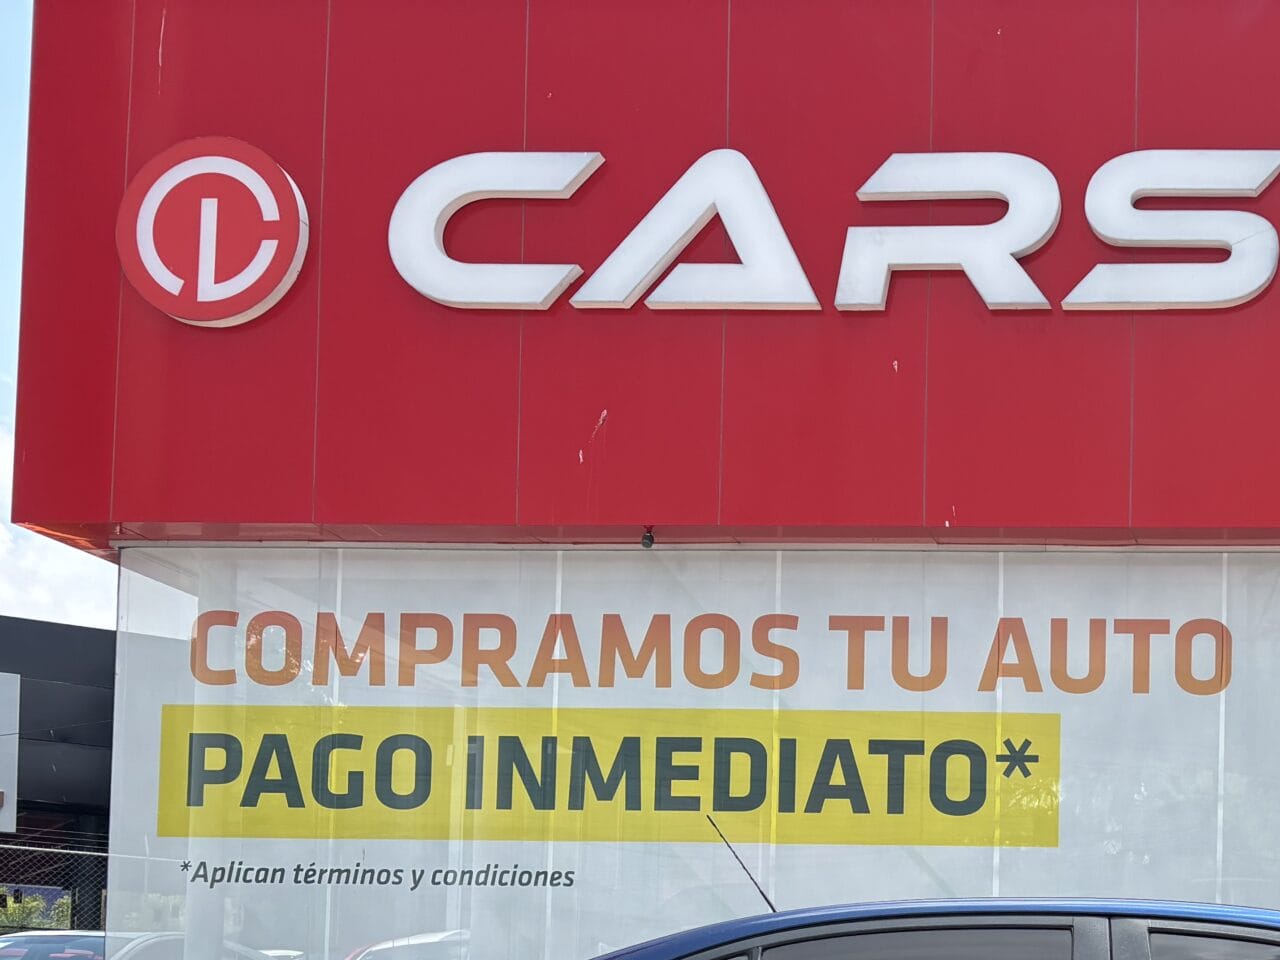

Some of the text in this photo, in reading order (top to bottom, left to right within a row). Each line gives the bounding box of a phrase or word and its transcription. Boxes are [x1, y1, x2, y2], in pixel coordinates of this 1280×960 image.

[189, 610, 1233, 697] COMPRAMOS TU AUTO
[185, 732, 433, 810] PAGO
[293, 862, 404, 887] términos
[409, 868, 426, 892] y
[430, 863, 576, 889] condiciones
